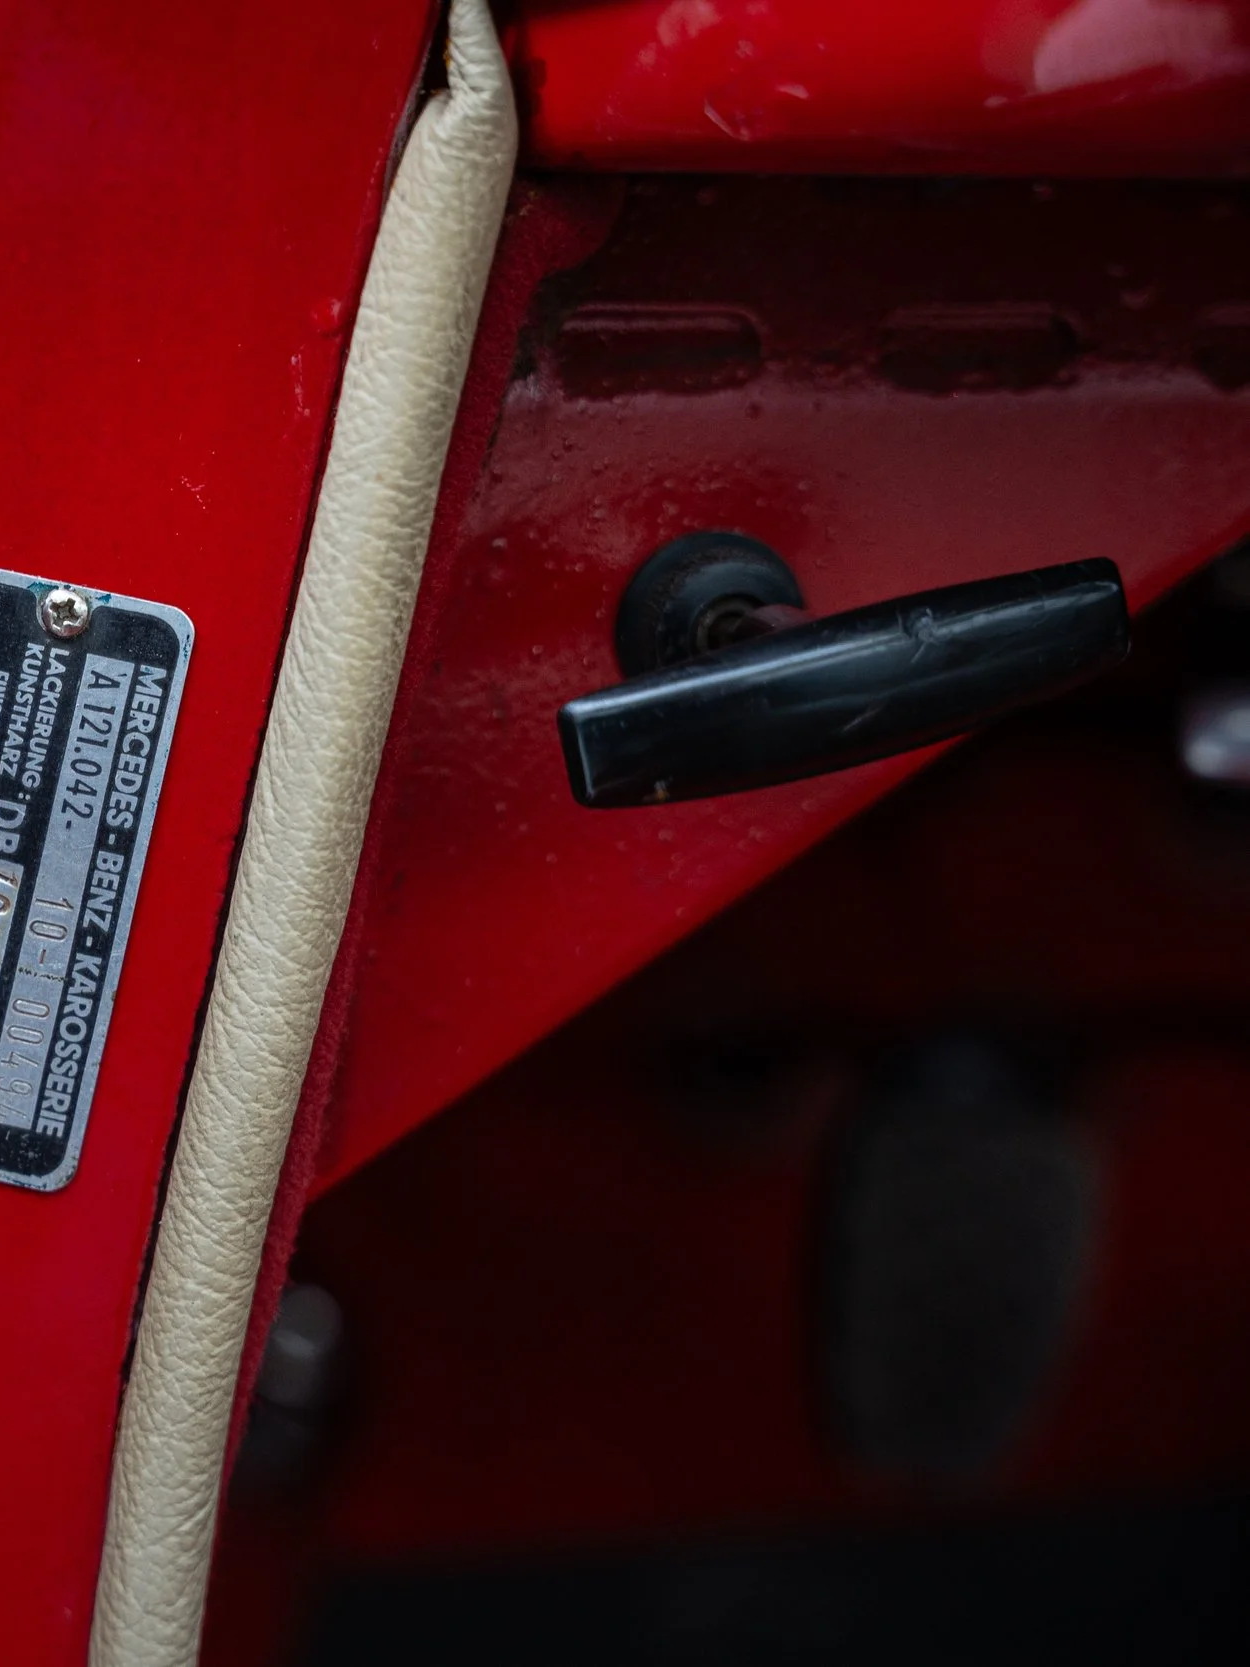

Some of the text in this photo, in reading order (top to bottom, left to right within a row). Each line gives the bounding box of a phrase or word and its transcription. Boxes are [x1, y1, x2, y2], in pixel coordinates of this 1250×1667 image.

[17, 647, 70, 789] LACKIERUNG
[86, 669, 122, 695] A
[102, 663, 167, 829] MERCEDES
[80, 850, 124, 931] BENZ
[34, 952, 102, 1137] KAROSSERIE
